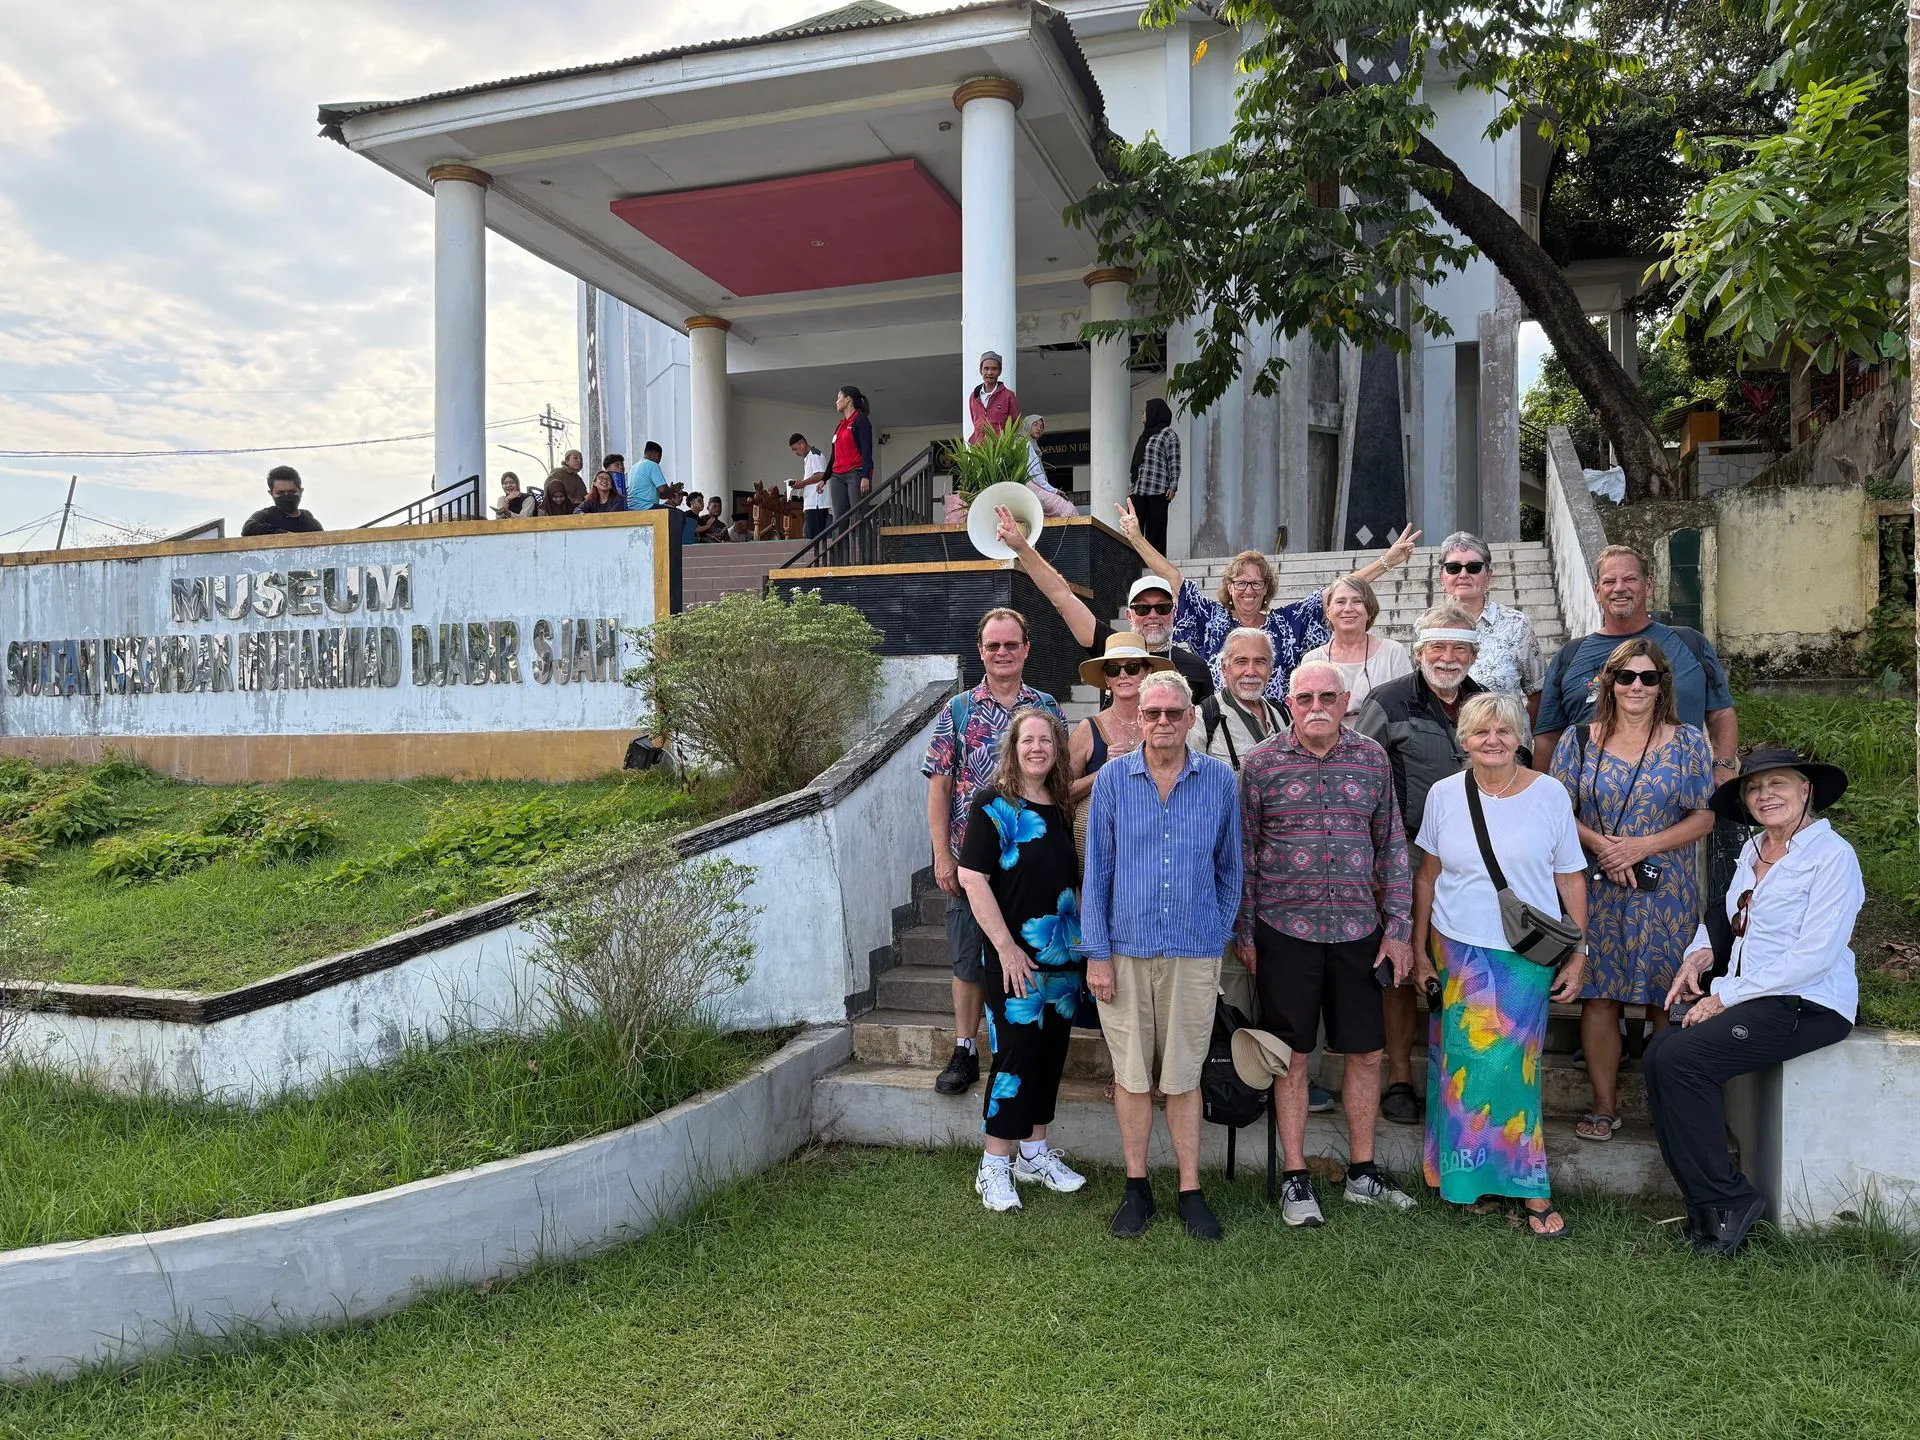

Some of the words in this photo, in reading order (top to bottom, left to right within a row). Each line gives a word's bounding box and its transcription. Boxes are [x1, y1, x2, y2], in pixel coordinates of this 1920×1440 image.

[171, 562, 413, 622] MUSEUM
[6, 638, 101, 697] SULTAN
[103, 633, 235, 695] ISKANDAR
[238, 626, 403, 692] MUHAMMAD
[411, 620, 523, 687] DJABIR
[532, 617, 620, 685] SJAH
